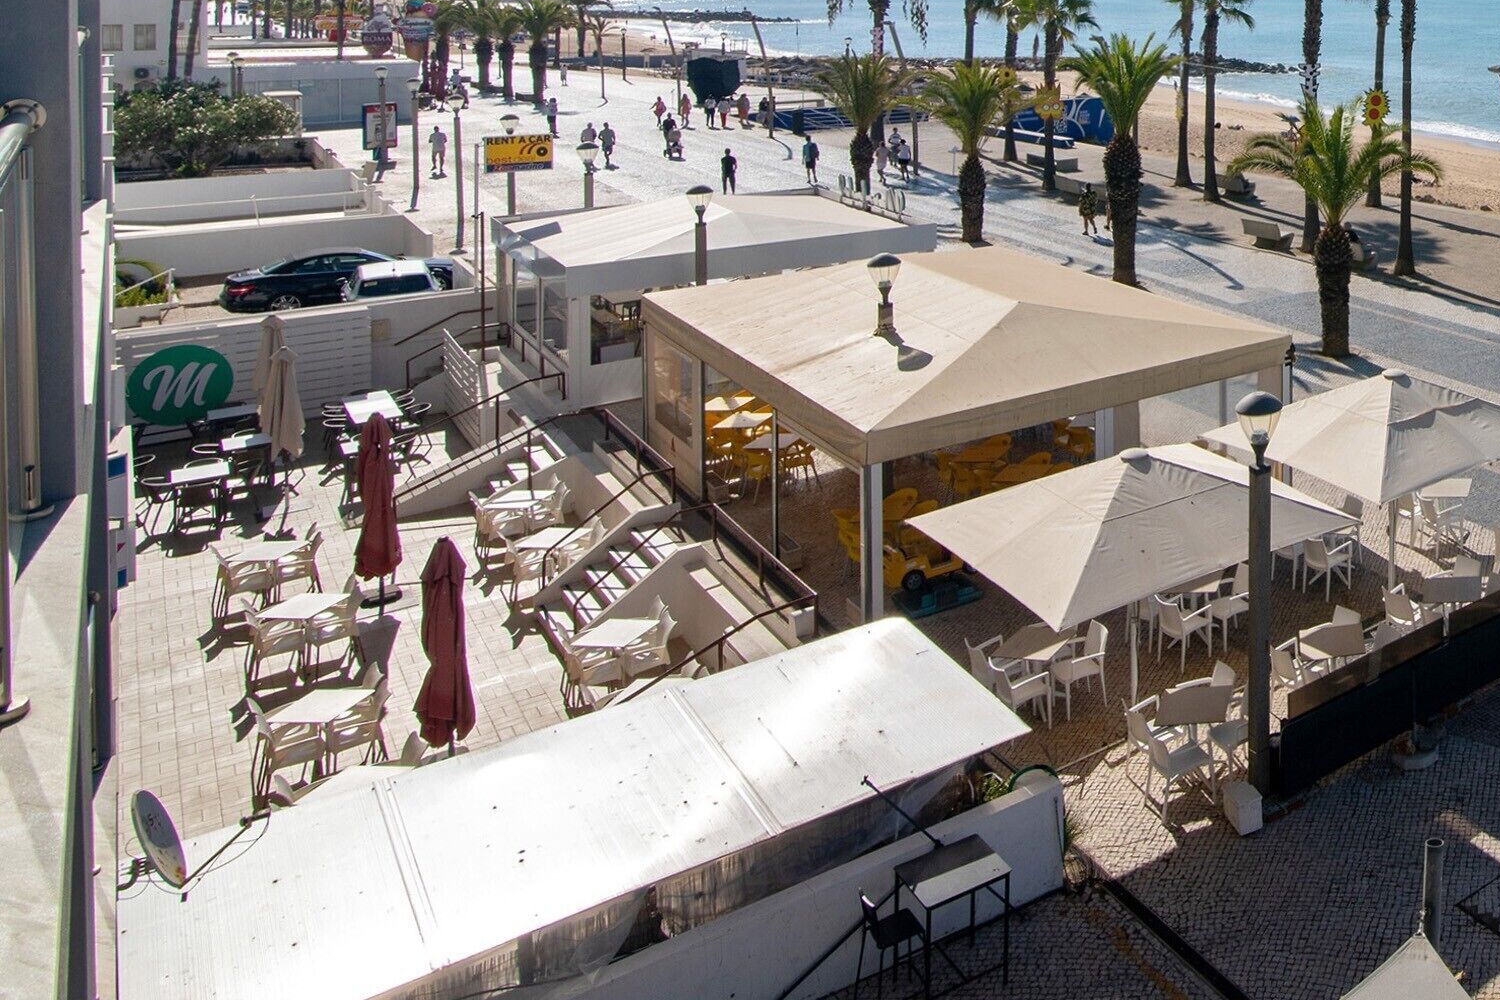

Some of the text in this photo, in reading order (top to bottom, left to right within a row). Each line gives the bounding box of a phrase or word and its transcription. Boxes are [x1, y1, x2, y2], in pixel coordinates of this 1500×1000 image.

[487, 134, 551, 146] RENT A CAR
